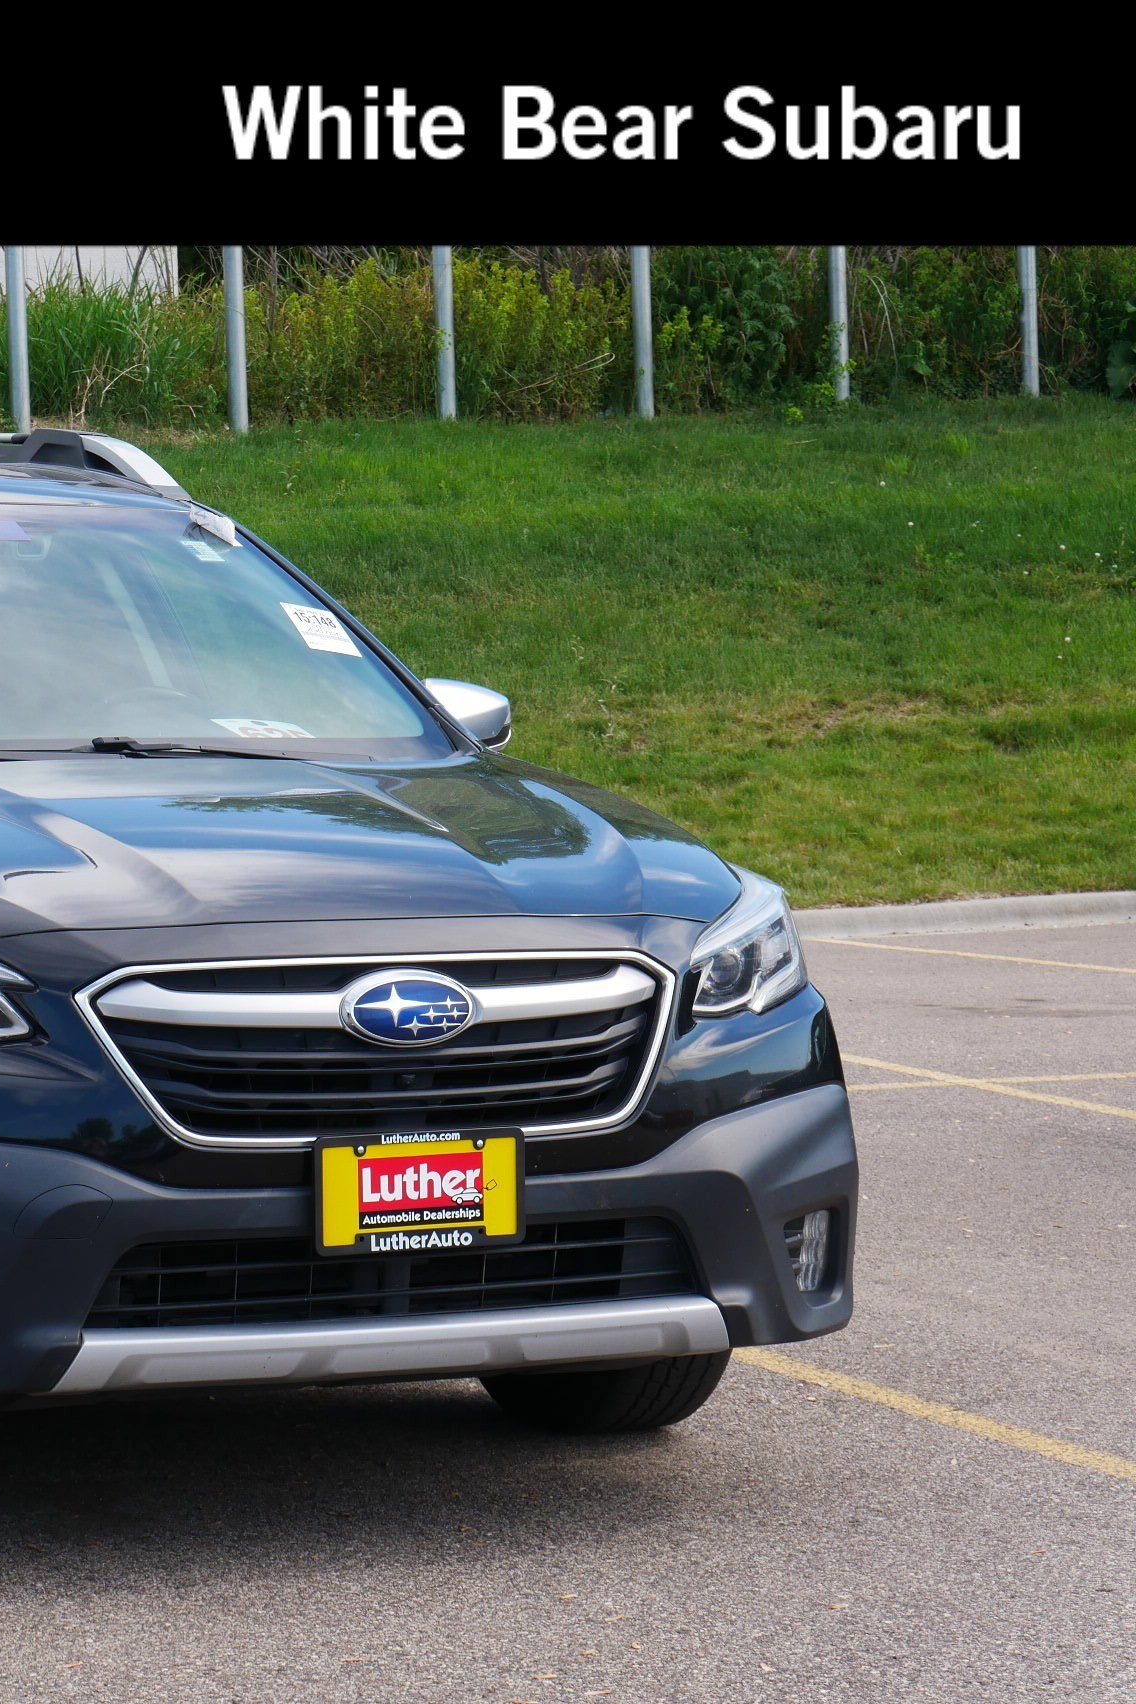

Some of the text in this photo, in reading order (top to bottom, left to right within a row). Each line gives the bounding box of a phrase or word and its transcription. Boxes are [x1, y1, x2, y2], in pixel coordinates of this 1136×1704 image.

[381, 1131, 461, 1145] LutherAuto.com
[361, 1162, 481, 1204] Luther
[362, 1208, 481, 1225] Automobile Dealerships
[370, 1229, 473, 1252] LutherAuto
